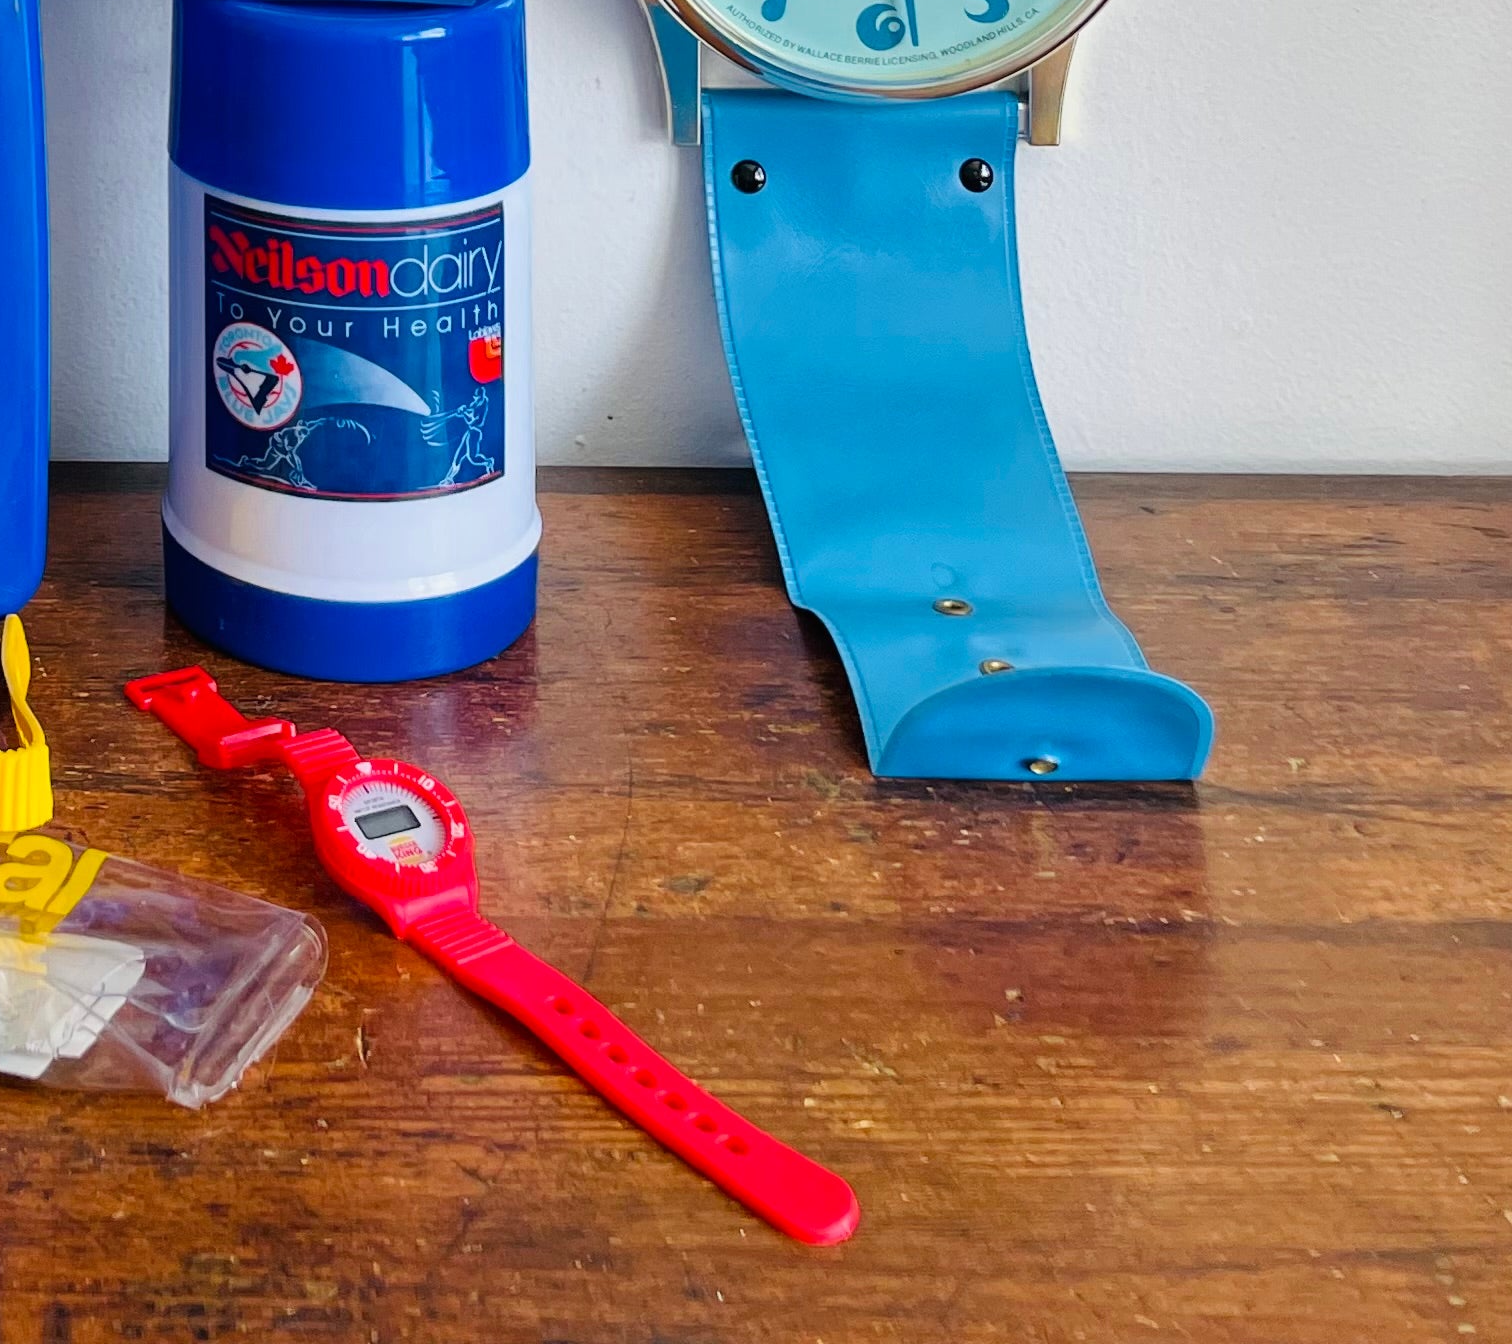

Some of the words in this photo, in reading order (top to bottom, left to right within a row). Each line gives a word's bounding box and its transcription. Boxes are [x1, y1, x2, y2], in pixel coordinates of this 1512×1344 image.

[726, 4, 782, 43] AUTHORIZED
[782, 39, 796, 52] BY
[796, 44, 846, 63] WALLACE
[844, 55, 881, 65] BERRIE
[940, 31, 997, 57] WOODLAND
[1025, 6, 1039, 21] CA
[856, 3, 906, 51] 6
[208, 224, 389, 298] Neilson
[389, 238, 503, 298] dairy
[216, 291, 244, 320] To
[266, 305, 354, 338] Your
[383, 300, 499, 338] Health
[417, 775, 436, 791] 10
